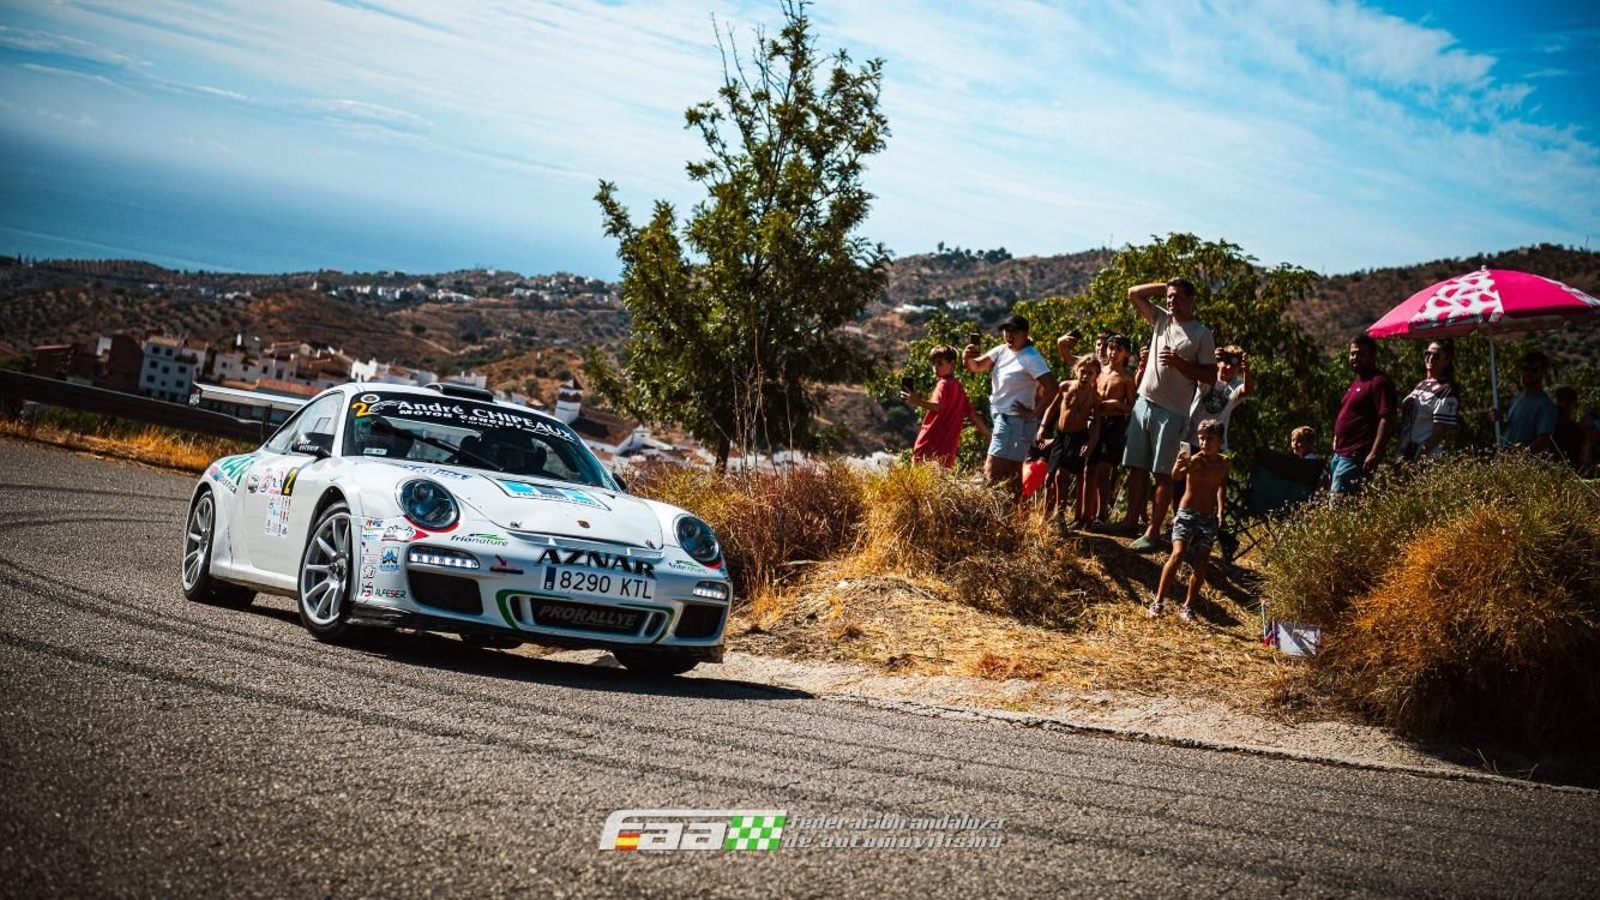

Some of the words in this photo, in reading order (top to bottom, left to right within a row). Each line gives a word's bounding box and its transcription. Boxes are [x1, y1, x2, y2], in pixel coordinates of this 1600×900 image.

[352, 402, 370, 417] 2
[398, 401, 464, 415] André
[472, 408, 575, 441] CHIPEAUX
[399, 409, 453, 419] MOTOR
[283, 467, 299, 495] 2
[450, 533, 508, 547] frianature
[532, 548, 657, 580] AZNAR
[560, 570, 611, 594] 8290
[620, 577, 652, 600] KTL
